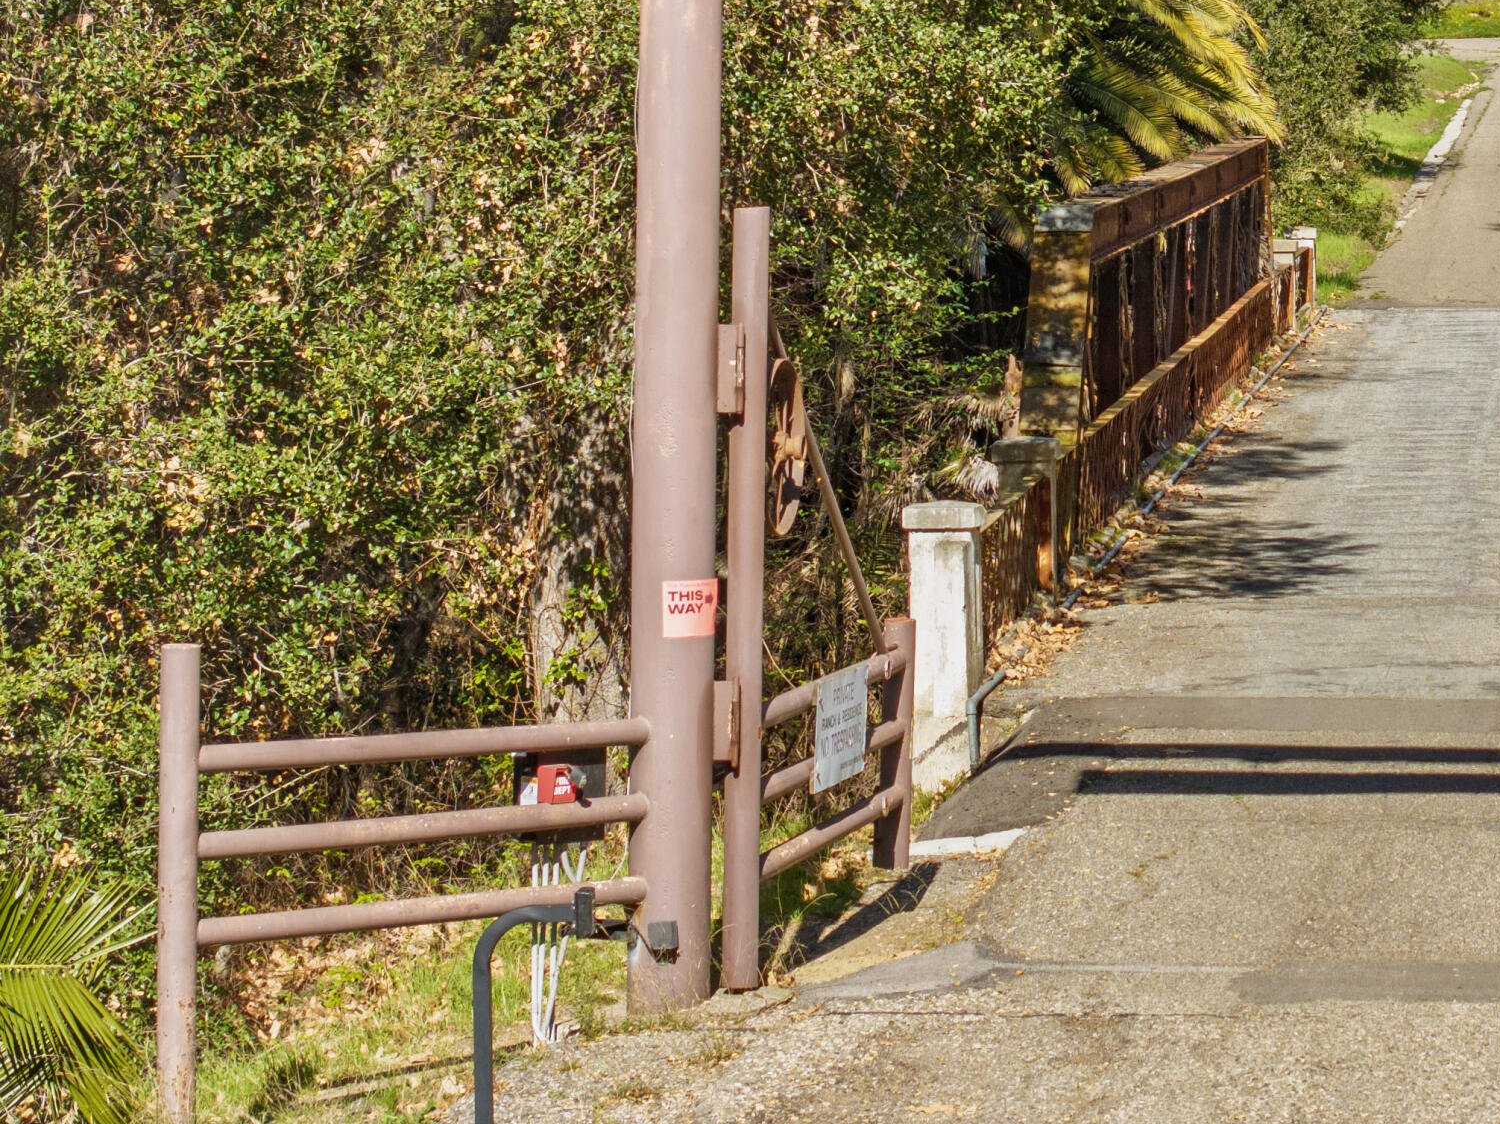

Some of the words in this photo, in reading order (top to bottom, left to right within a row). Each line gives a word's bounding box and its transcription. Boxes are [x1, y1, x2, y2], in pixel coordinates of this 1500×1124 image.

[668, 590, 703, 601] THIS
[668, 603, 703, 614] WAY
[833, 683, 854, 708] PRIVATE
[822, 716, 836, 731] RANCH
[821, 736, 829, 759] NO
[832, 723, 862, 755] TRESPASSING
[554, 785, 571, 795] DEPT
